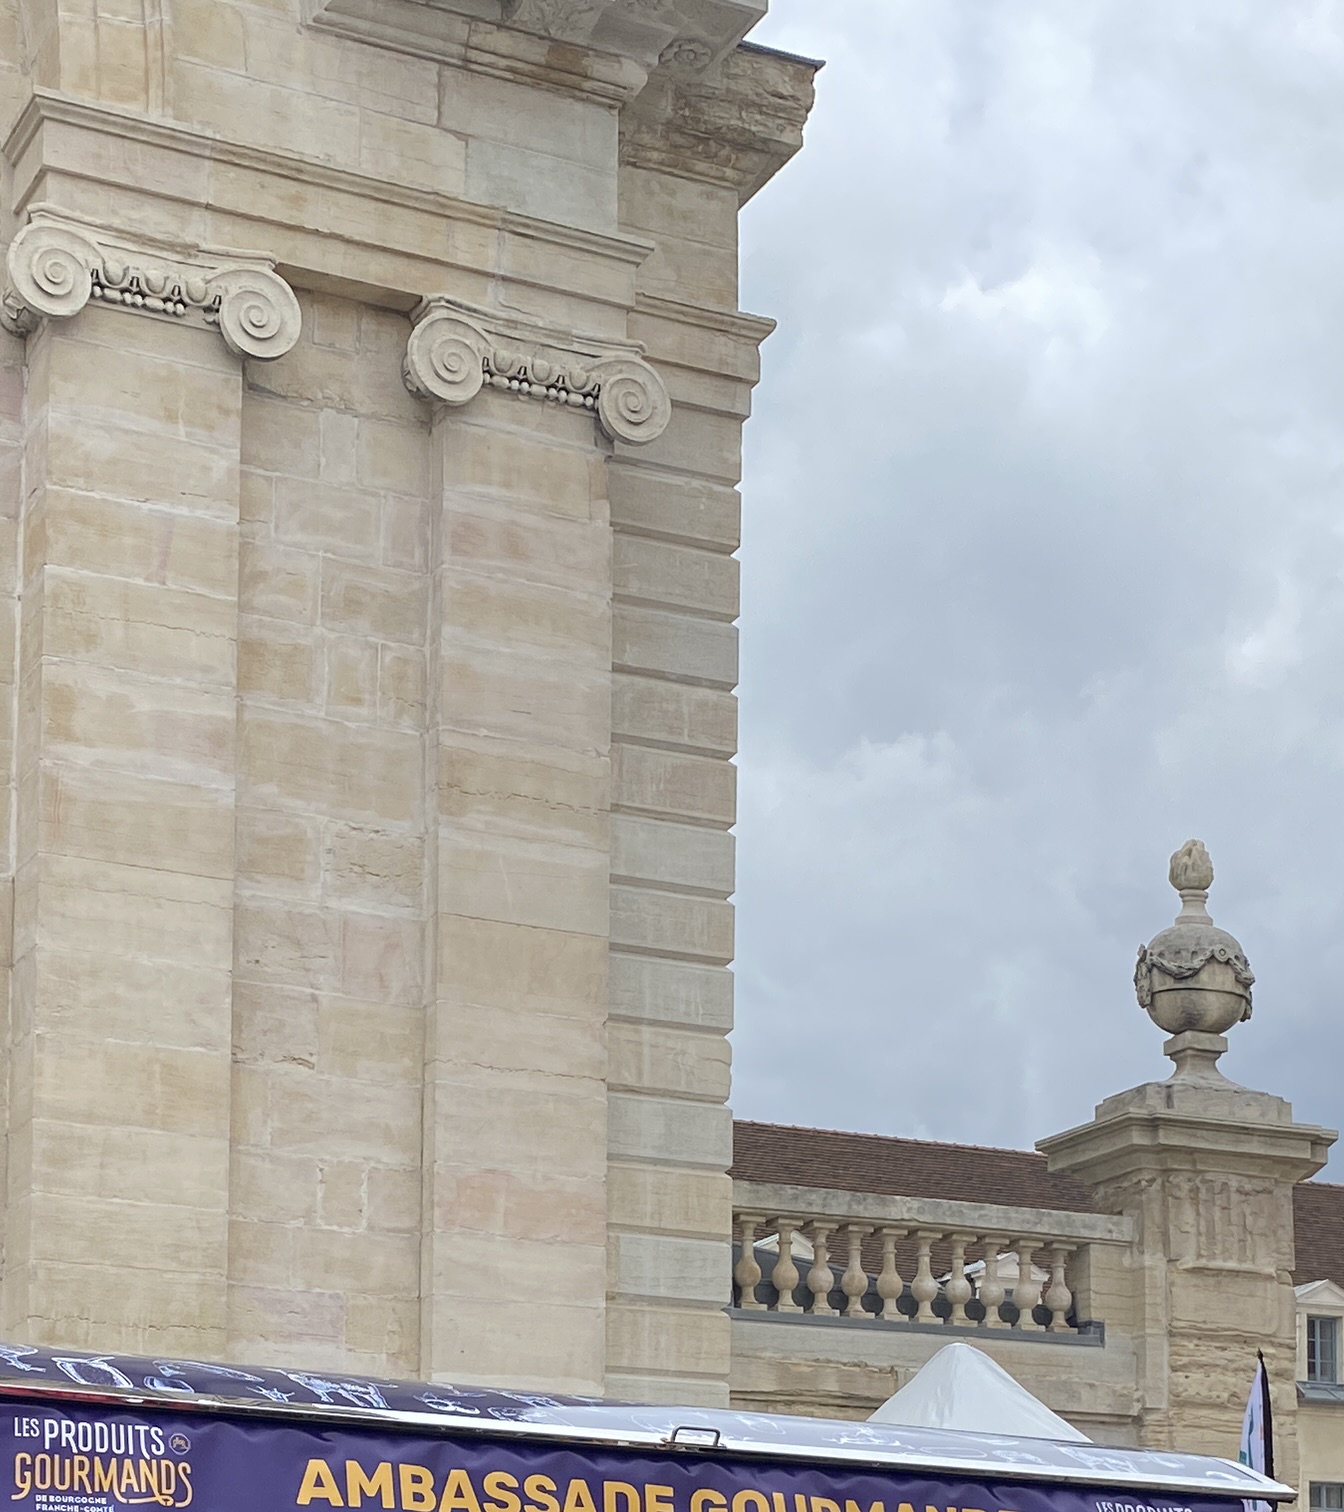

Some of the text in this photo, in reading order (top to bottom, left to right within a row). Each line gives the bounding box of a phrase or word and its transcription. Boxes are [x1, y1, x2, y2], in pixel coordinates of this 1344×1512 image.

[14, 1417, 165, 1460] LES PRODUITS
[11, 1452, 193, 1508] GOURMANDS
[35, 1494, 107, 1504] DE BOURGOGNE
[35, 1504, 115, 1512] FRANCHE-COMTÉ
